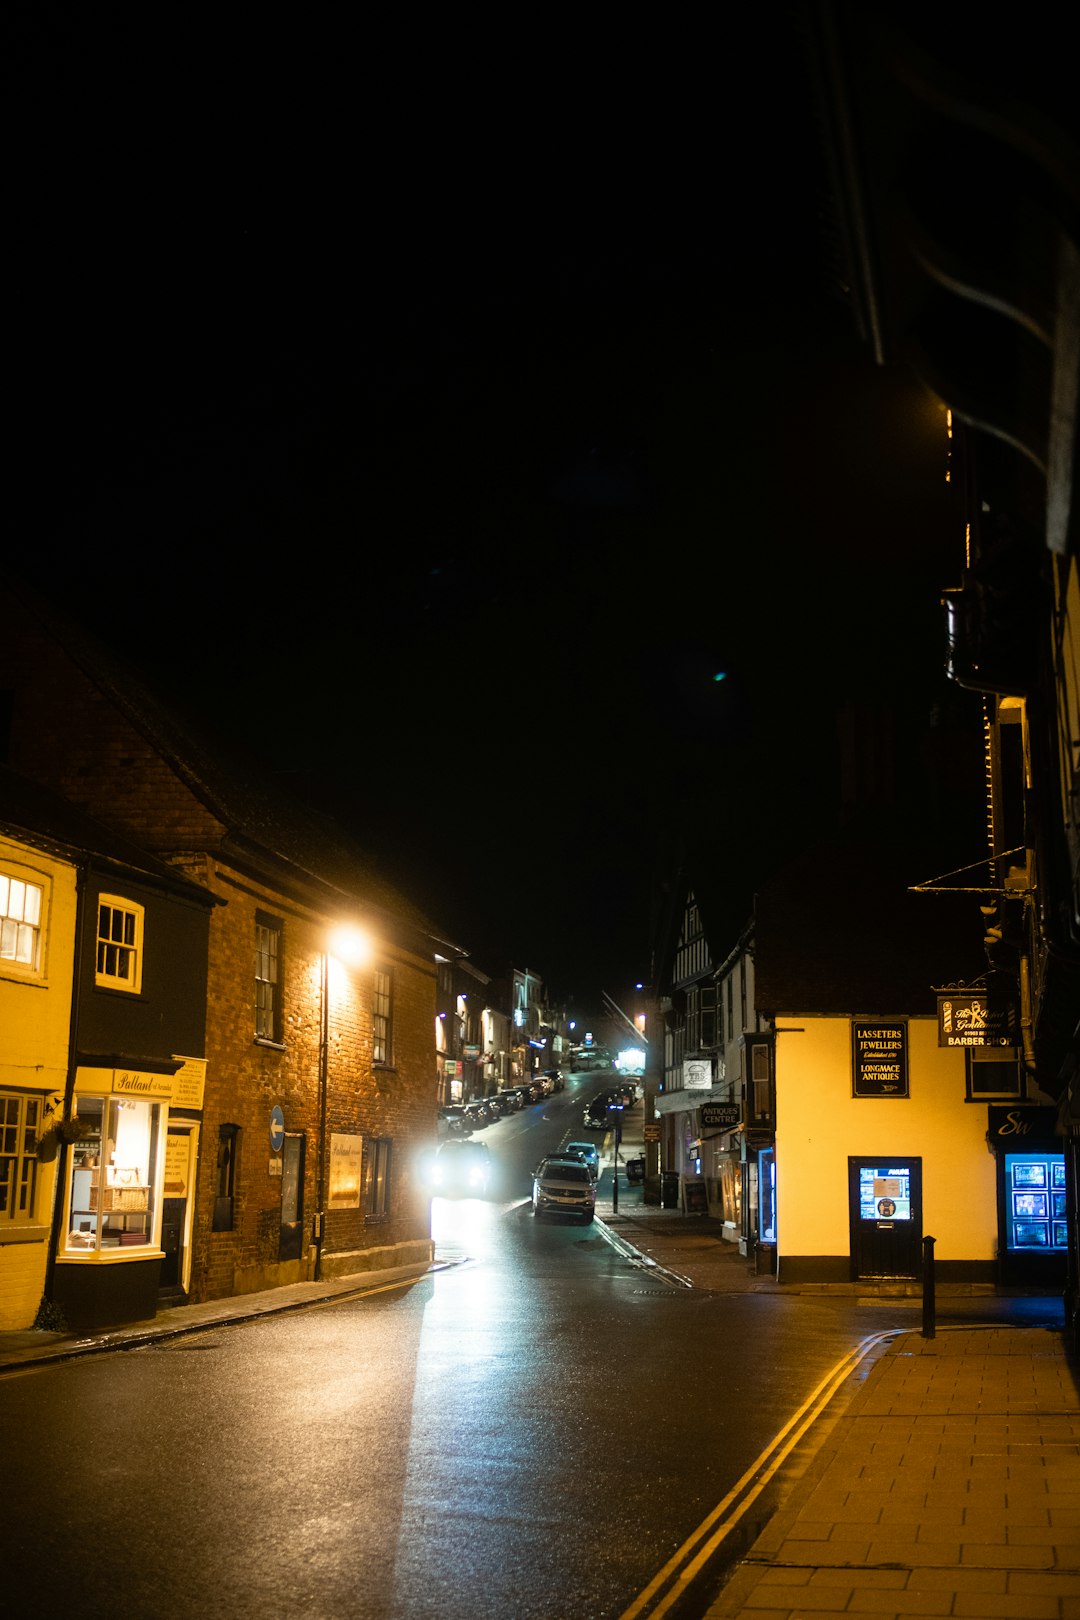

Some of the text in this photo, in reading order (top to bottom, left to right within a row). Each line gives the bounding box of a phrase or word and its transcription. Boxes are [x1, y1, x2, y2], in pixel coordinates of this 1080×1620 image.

[857, 1030, 902, 1038] LASSETERS
[860, 1041, 902, 1050] JEWELLERS
[947, 1037, 1013, 1046] BARBER SHOP
[860, 1064, 901, 1073] LONGMACE
[862, 1073, 900, 1081] ANTIQUES
[118, 1073, 154, 1092] Pallant
[703, 1107, 738, 1115] ANTIQUES
[704, 1115, 736, 1123] CENTRE
